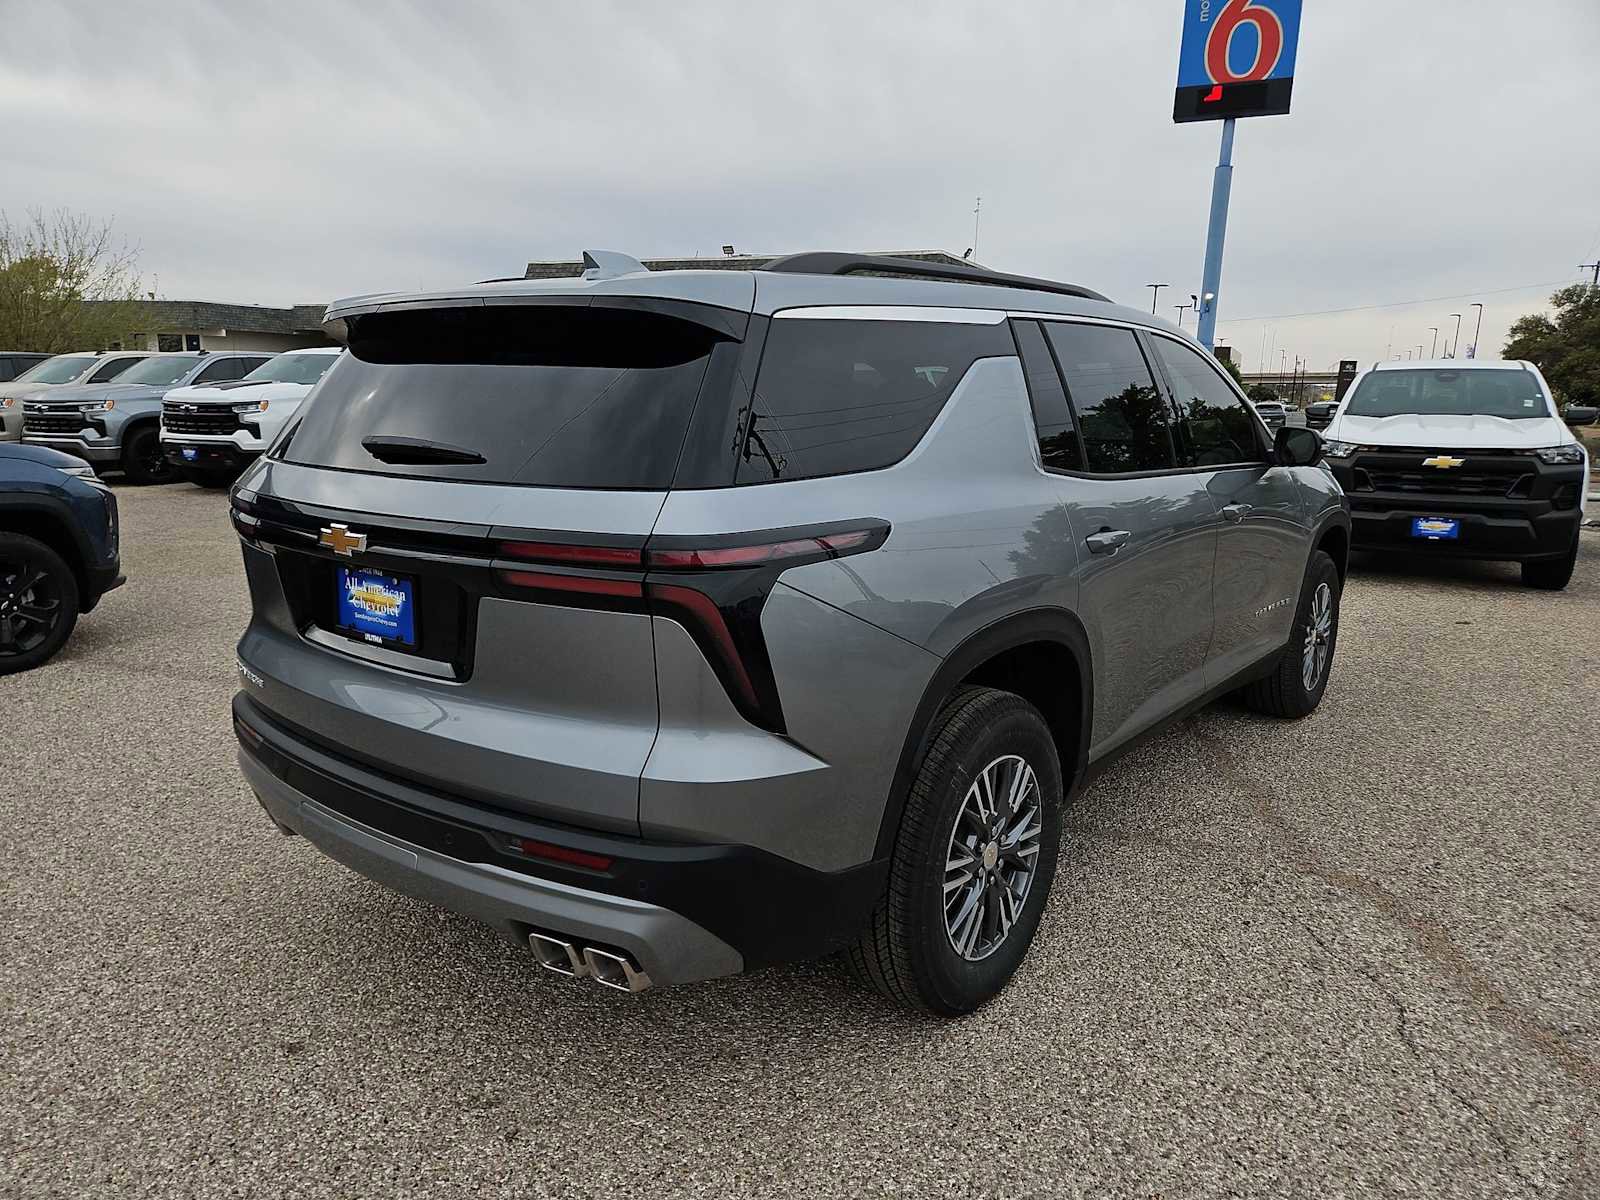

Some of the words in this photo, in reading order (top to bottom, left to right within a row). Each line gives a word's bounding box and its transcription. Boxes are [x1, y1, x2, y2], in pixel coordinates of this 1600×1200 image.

[1200, 0, 1210, 22] mo
[1204, 0, 1284, 84] 6
[352, 594, 401, 617] Chevrolet
